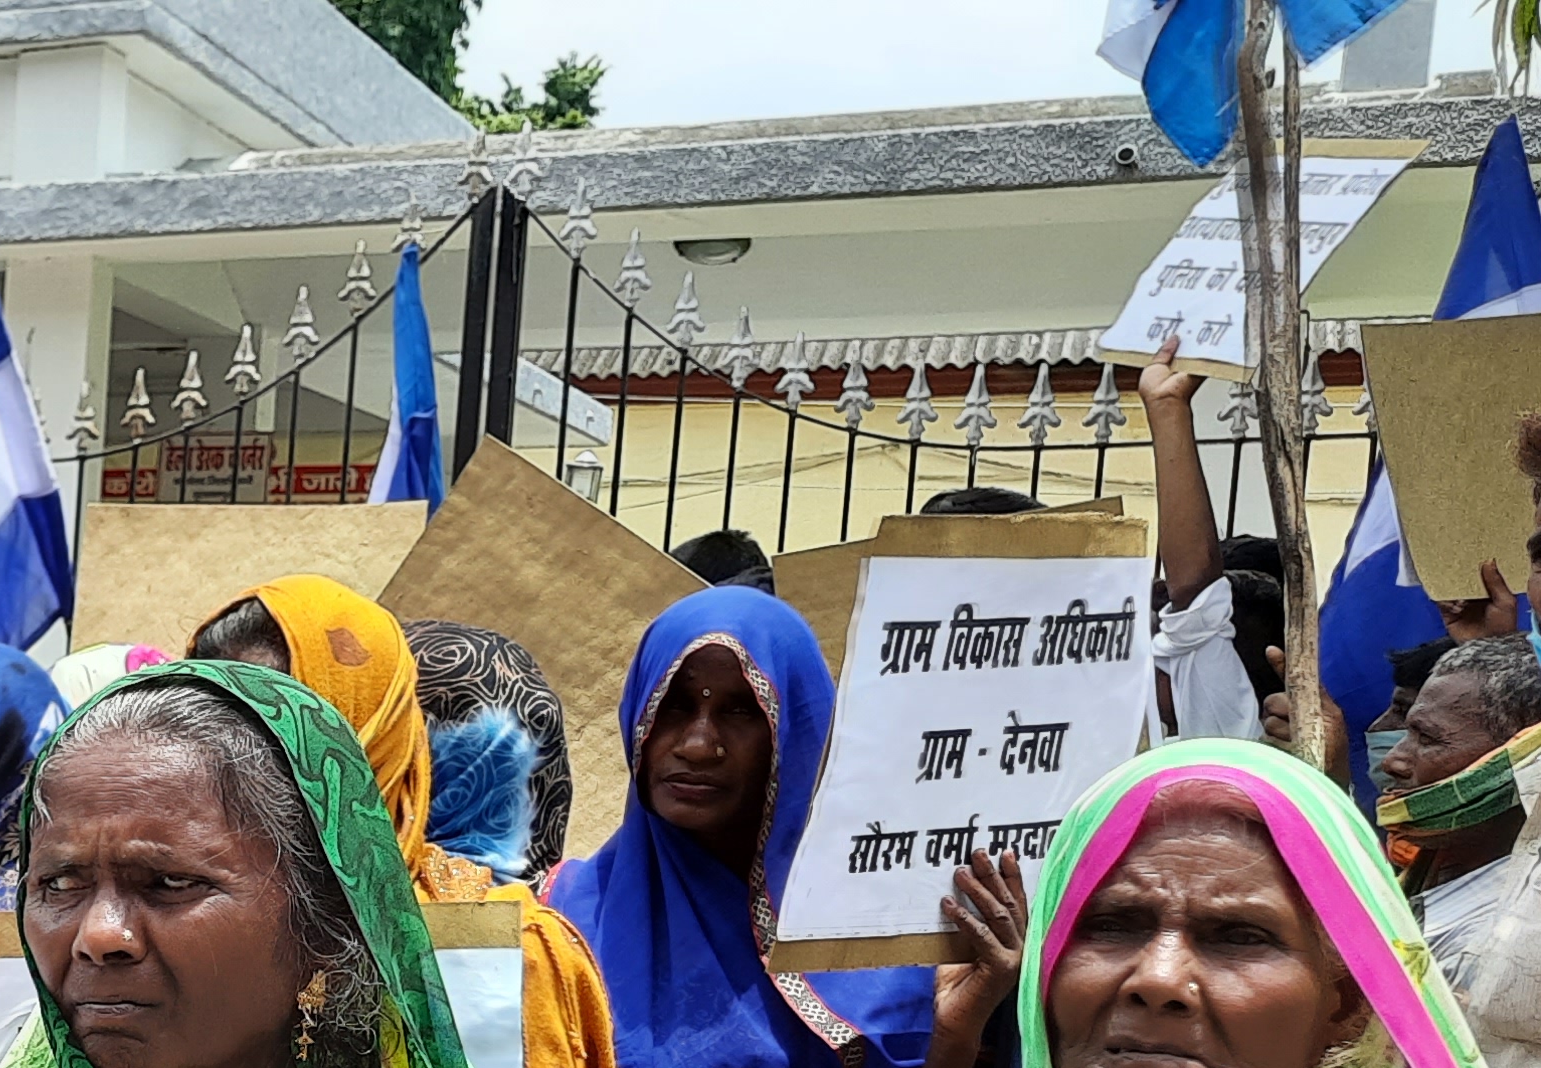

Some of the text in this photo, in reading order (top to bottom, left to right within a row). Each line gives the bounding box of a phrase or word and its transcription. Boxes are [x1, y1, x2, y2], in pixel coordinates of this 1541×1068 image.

[1206, 261, 1238, 291] को
[1196, 314, 1233, 346] करो
[881, 597, 1135, 675] ग्राम विकास अधिकारी
[916, 711, 1069, 783] ग्राम - देनवा
[849, 822, 918, 873] सौरभ
[926, 814, 979, 867] वर्मा
